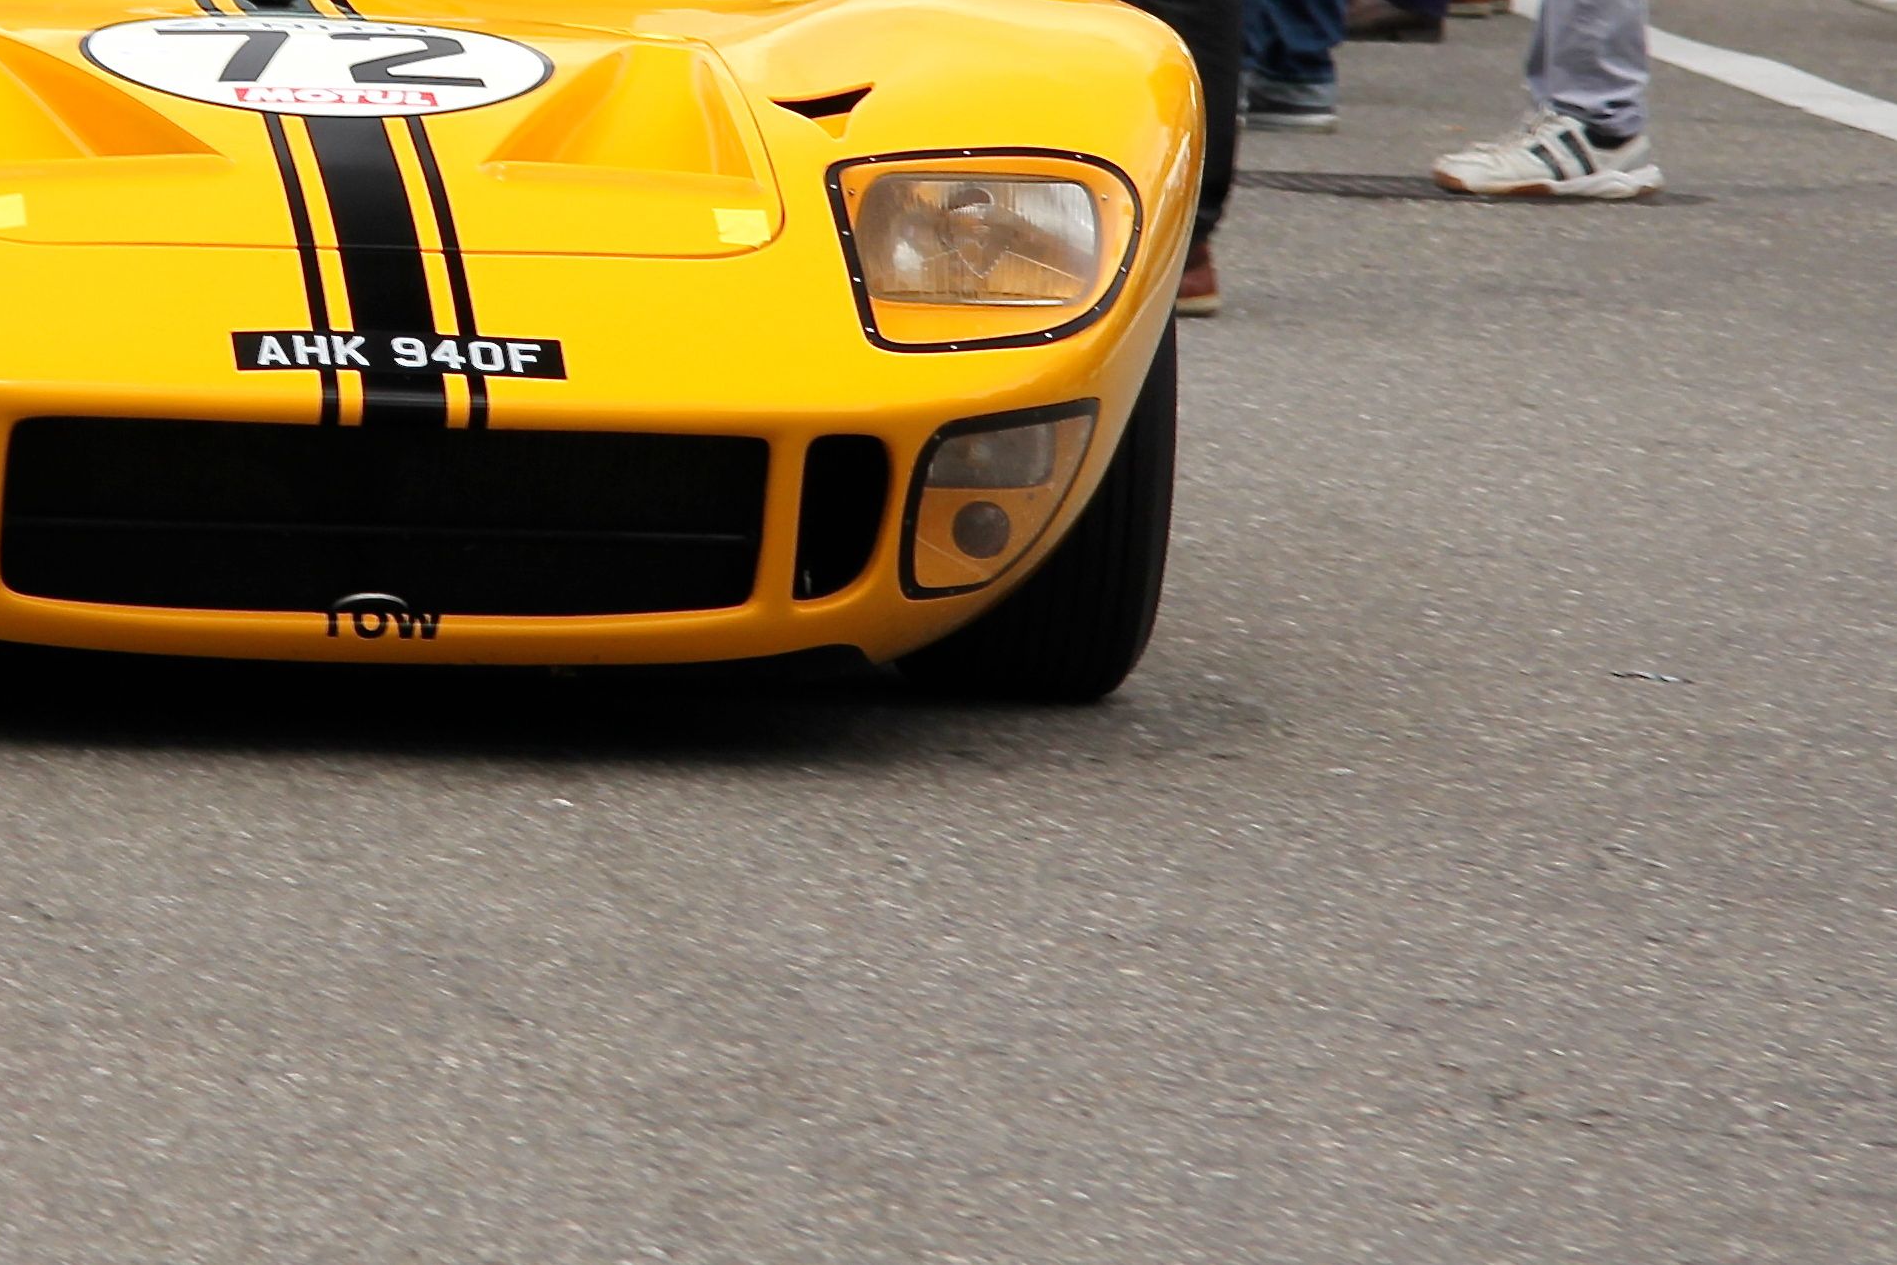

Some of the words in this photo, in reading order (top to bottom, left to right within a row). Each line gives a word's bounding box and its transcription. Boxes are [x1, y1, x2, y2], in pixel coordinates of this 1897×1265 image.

[155, 28, 487, 88] 72
[243, 87, 435, 107] MOTUL
[256, 334, 371, 366] AHK
[390, 336, 542, 373] 940F
[324, 610, 442, 640] TOW
